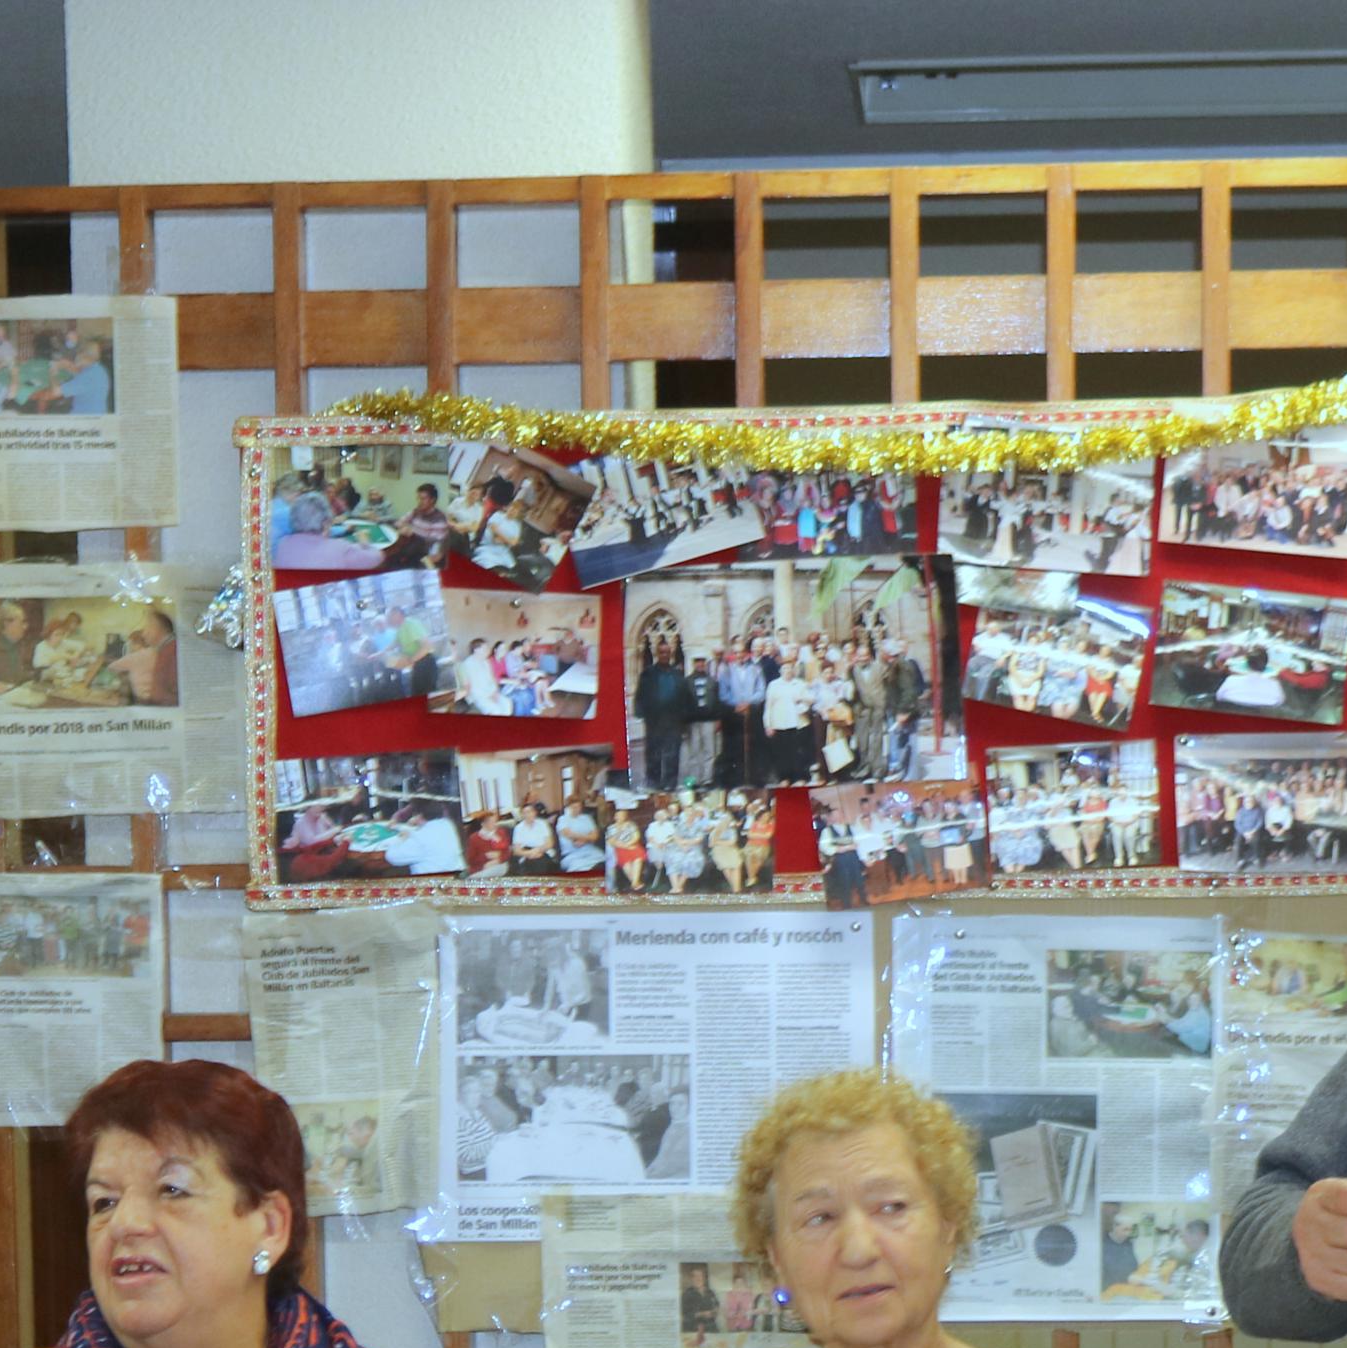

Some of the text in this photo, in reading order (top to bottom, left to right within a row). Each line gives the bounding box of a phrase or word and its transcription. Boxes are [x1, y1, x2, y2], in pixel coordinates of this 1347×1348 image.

[28, 723, 52, 738] por
[53, 721, 85, 735] 2018
[87, 723, 104, 733] en
[106, 719, 129, 732] San
[132, 718, 172, 731] Millán
[616, 926, 843, 947] Merienda con café y roscón
[459, 1206, 479, 1216] Los
[459, 1219, 473, 1230] de
[476, 1219, 497, 1230] San
